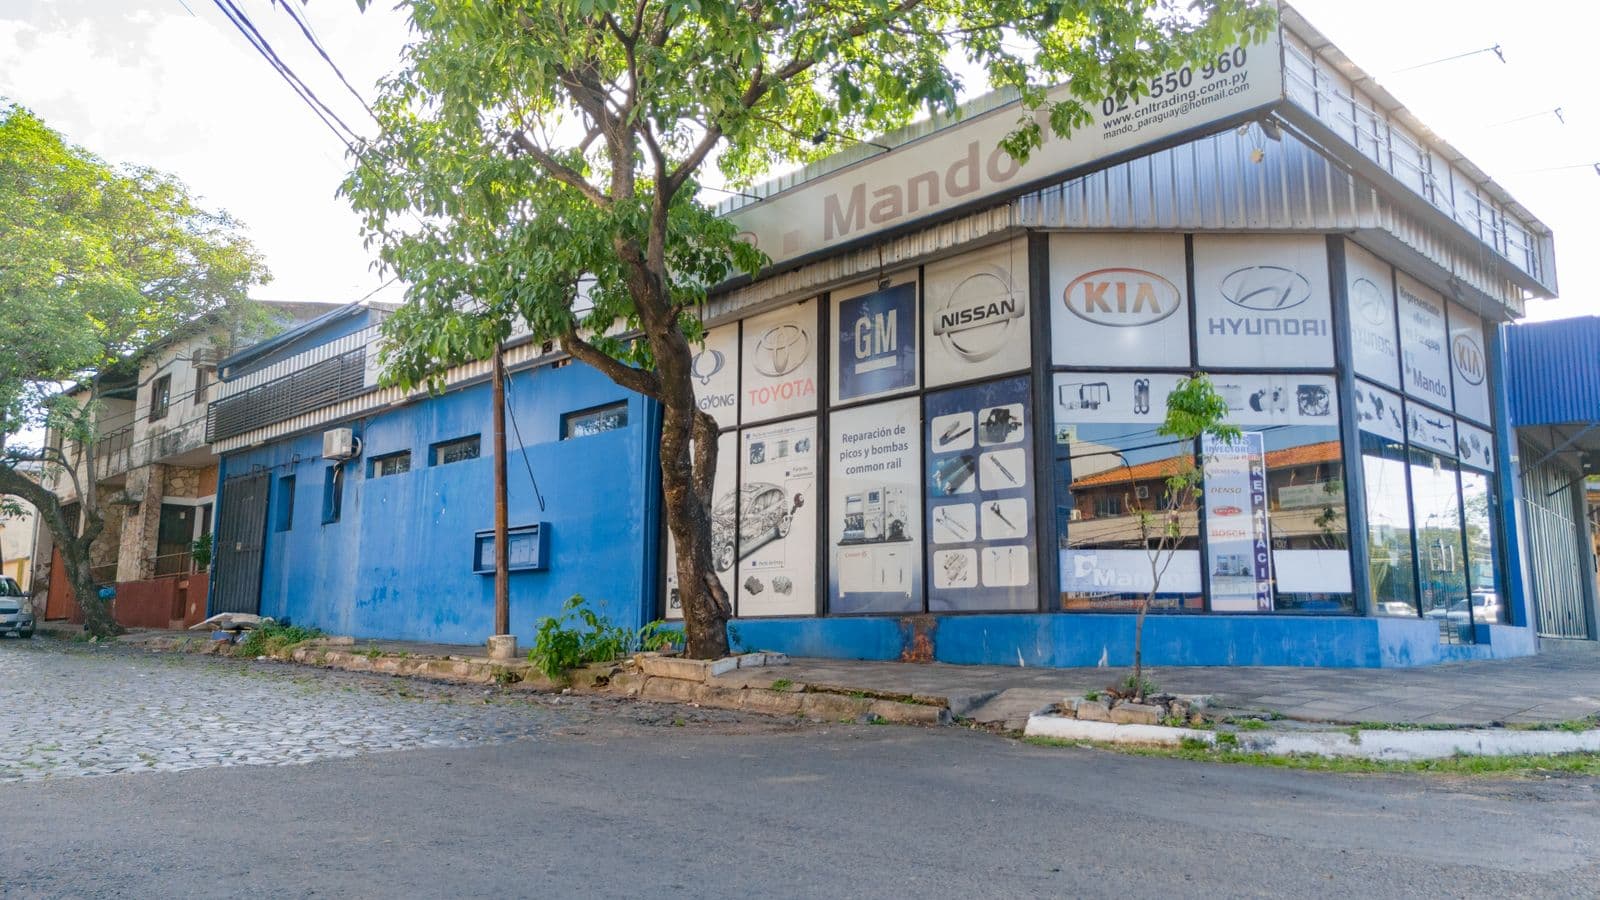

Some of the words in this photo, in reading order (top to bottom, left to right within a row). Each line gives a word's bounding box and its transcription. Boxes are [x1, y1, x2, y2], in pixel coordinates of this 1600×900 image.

[1151, 67, 1192, 98] 550
[1201, 47, 1246, 79] 960
[1103, 71, 1248, 129] www.cnltrading.com.py
[1104, 83, 1249, 140] mando_paraguay@hotmail.com
[824, 141, 1021, 241] Mando
[1083, 281, 1162, 313] KIA
[941, 298, 1015, 329] NISSAN
[1208, 317, 1327, 337] HYUNDAI
[855, 309, 897, 359] GM
[1457, 345, 1482, 378] KIA
[749, 378, 816, 407] TOYOTA
[1413, 368, 1447, 398] Mando
[842, 426, 892, 444] Reparación
[894, 424, 906, 436] de
[839, 446, 862, 462] picos
[863, 447, 870, 459] y
[871, 442, 909, 456] bombas
[845, 462, 885, 475] common
[886, 458, 902, 470] rail
[1210, 487, 1242, 495] DENSO
